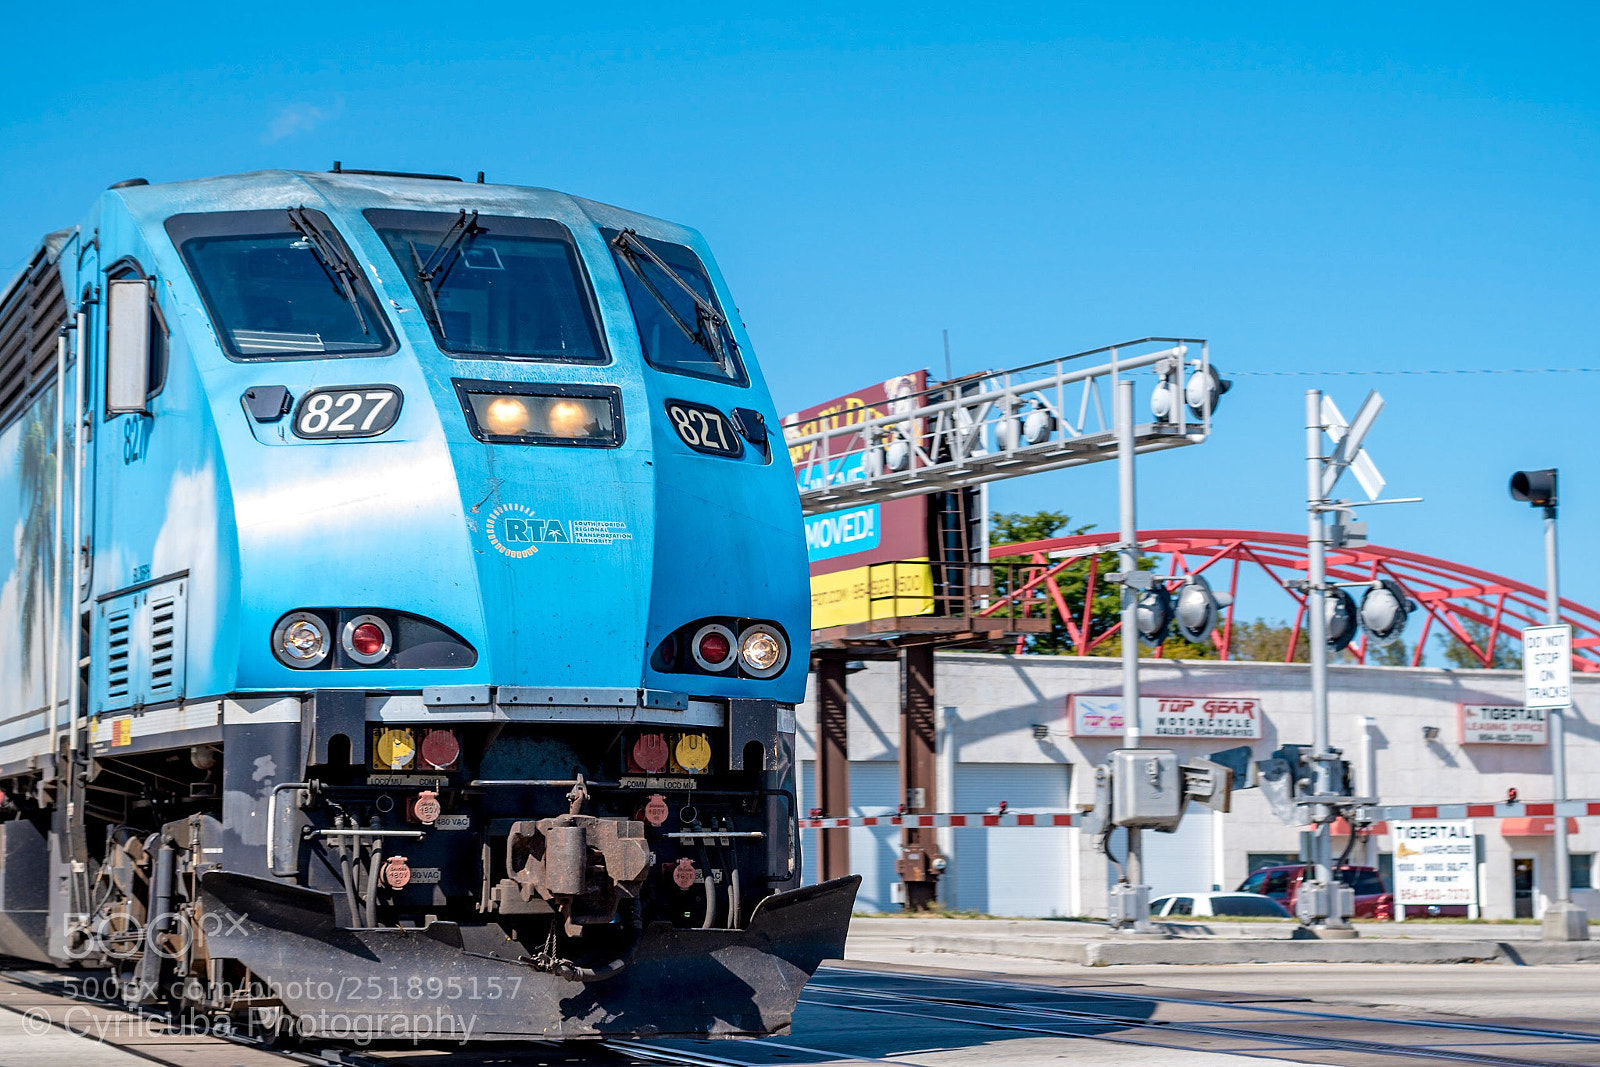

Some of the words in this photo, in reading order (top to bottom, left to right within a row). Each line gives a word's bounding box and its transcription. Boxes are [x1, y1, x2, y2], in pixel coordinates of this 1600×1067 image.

[301, 392, 393, 433] 827
[671, 406, 729, 450] 827
[505, 518, 569, 543] RTA
[1527, 636, 1541, 648] DO
[1546, 634, 1565, 647] NOT
[1534, 652, 1560, 665] STOP
[1540, 670, 1555, 682] ON
[1527, 686, 1568, 699] TRACKS
[1157, 699, 1195, 713] TOP
[1203, 700, 1255, 719] GEAR
[1480, 707, 1545, 721] TIGERTAIL
[1156, 717, 1252, 728] MOTORCYCLE
[1467, 722, 1507, 731] LEASING
[1511, 723, 1544, 732] OFFICE
[1155, 727, 1186, 735] SALES
[1396, 826, 1471, 839] TIGERTAIL
[424, 871, 440, 879] VAC
[1409, 875, 1428, 883] FOR
[1434, 875, 1459, 883] RENT
